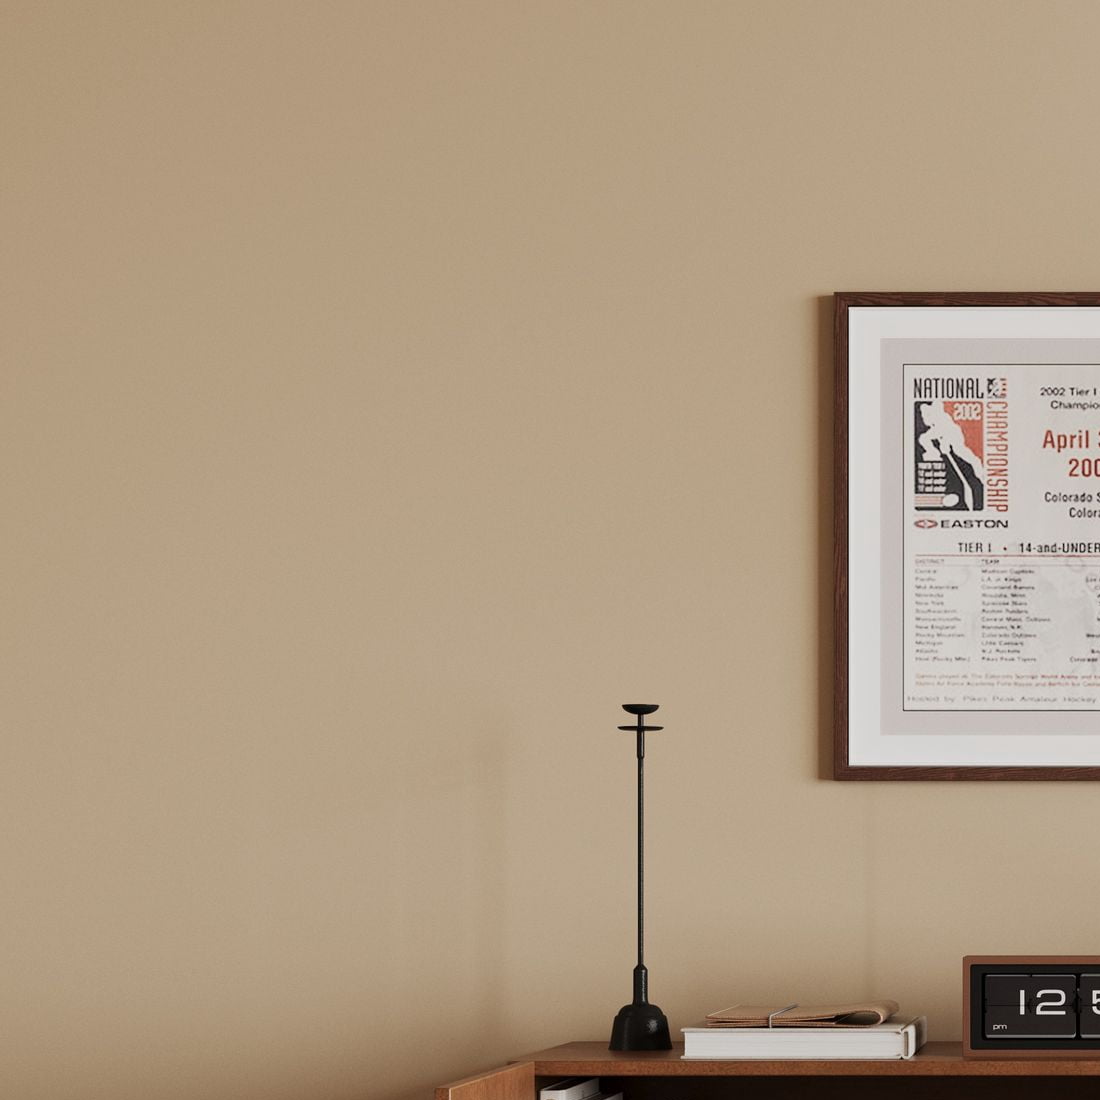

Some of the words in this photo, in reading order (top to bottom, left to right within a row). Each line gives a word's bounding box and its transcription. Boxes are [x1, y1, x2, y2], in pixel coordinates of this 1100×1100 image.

[914, 378, 984, 399] NATIONAL
[1041, 387, 1066, 396] 2002
[1070, 387, 1090, 396] Tier
[1094, 388, 1097, 396] I
[953, 403, 982, 421] 2002
[1043, 430, 1089, 453] April
[987, 402, 1009, 512] CHAMPIONSHIP
[1045, 492, 1093, 503] Colorado
[941, 520, 1008, 528] EASTON
[958, 542, 983, 553] TIER
[988, 543, 991, 553] I
[1020, 989, 1066, 1015] 12
